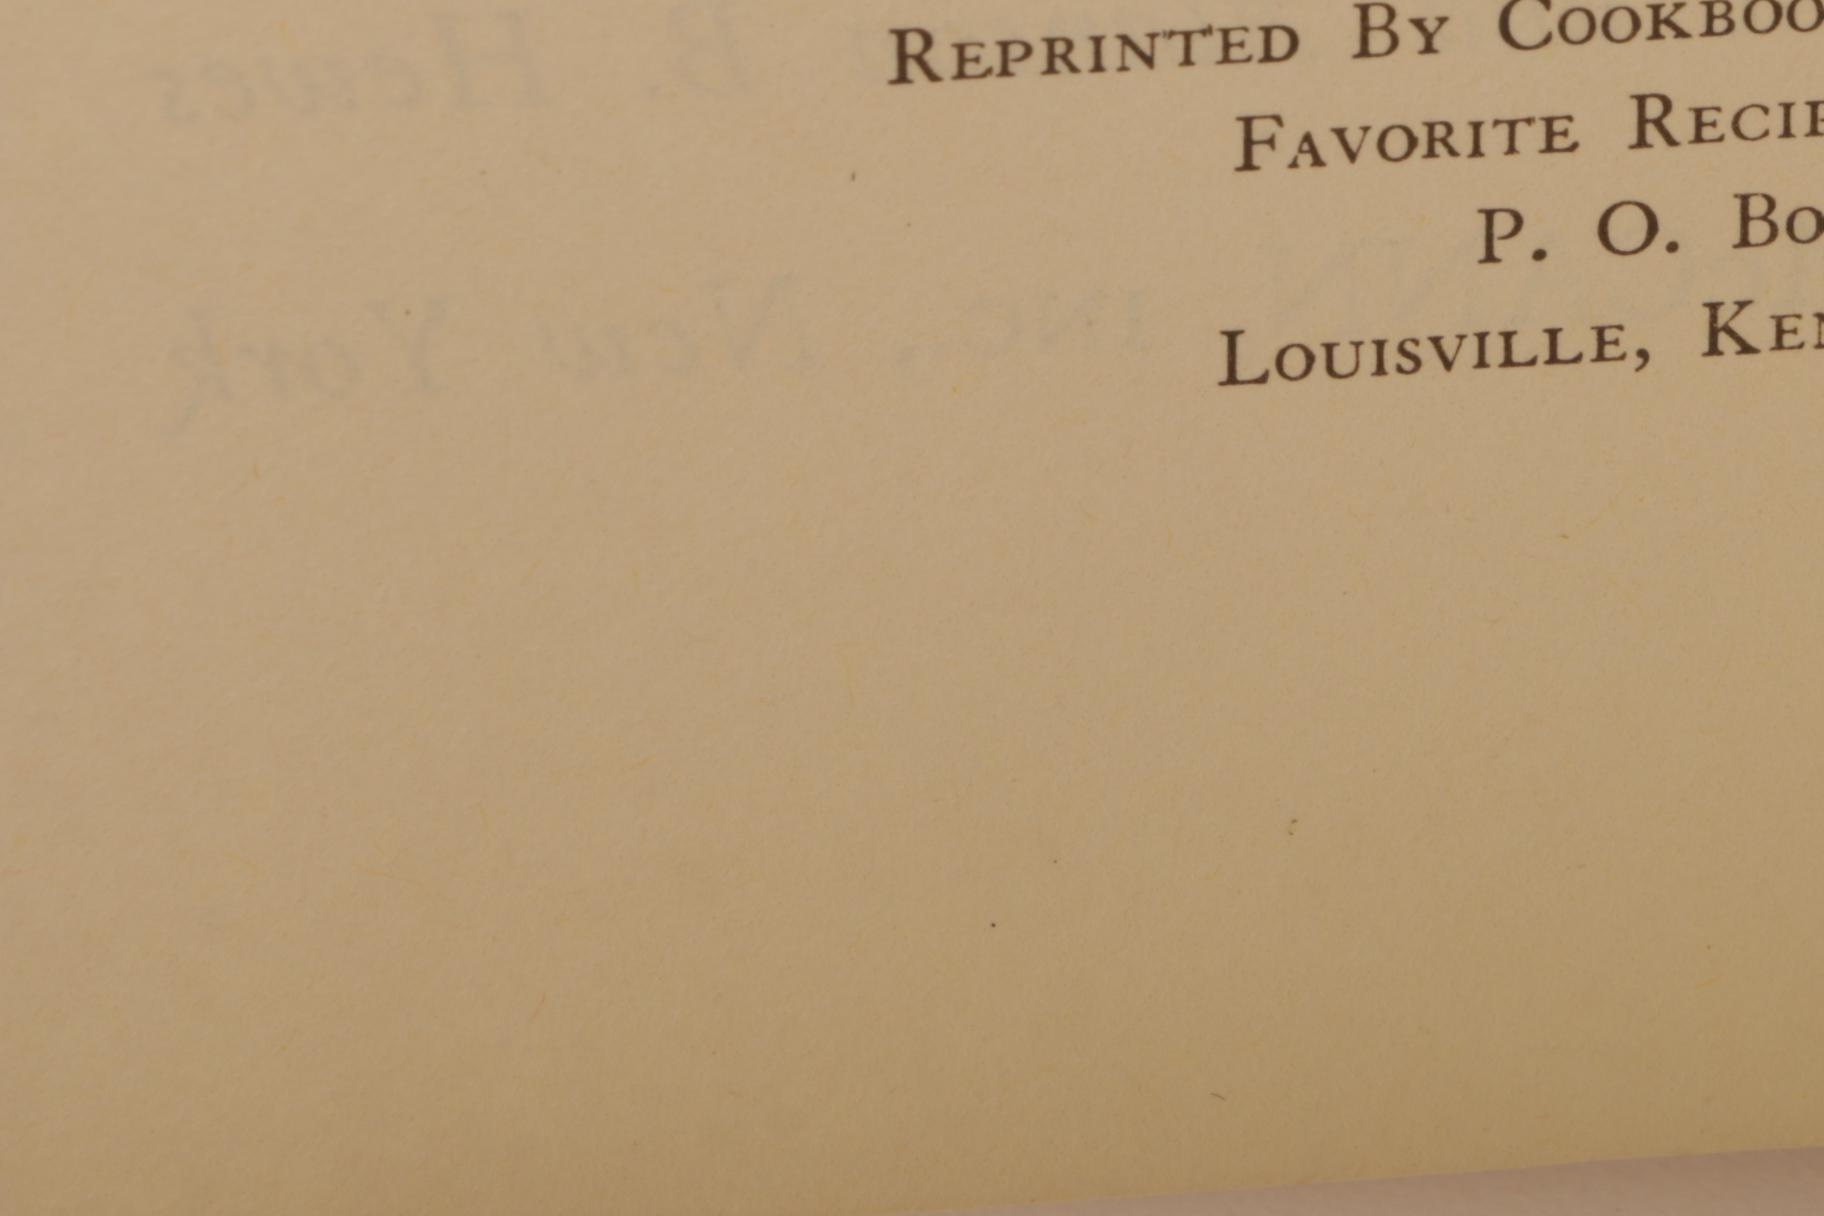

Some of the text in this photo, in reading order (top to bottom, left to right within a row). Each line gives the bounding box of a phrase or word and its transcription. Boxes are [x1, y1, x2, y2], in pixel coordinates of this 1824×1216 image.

[887, 23, 1301, 86] REPRINTED
[1351, 1, 1451, 60] BY
[1233, 113, 1581, 173] FAVORITE
[1476, 207, 1548, 265] P.
[1596, 199, 1680, 257] O.
[1217, 323, 1651, 388] LOUISVILLE,
